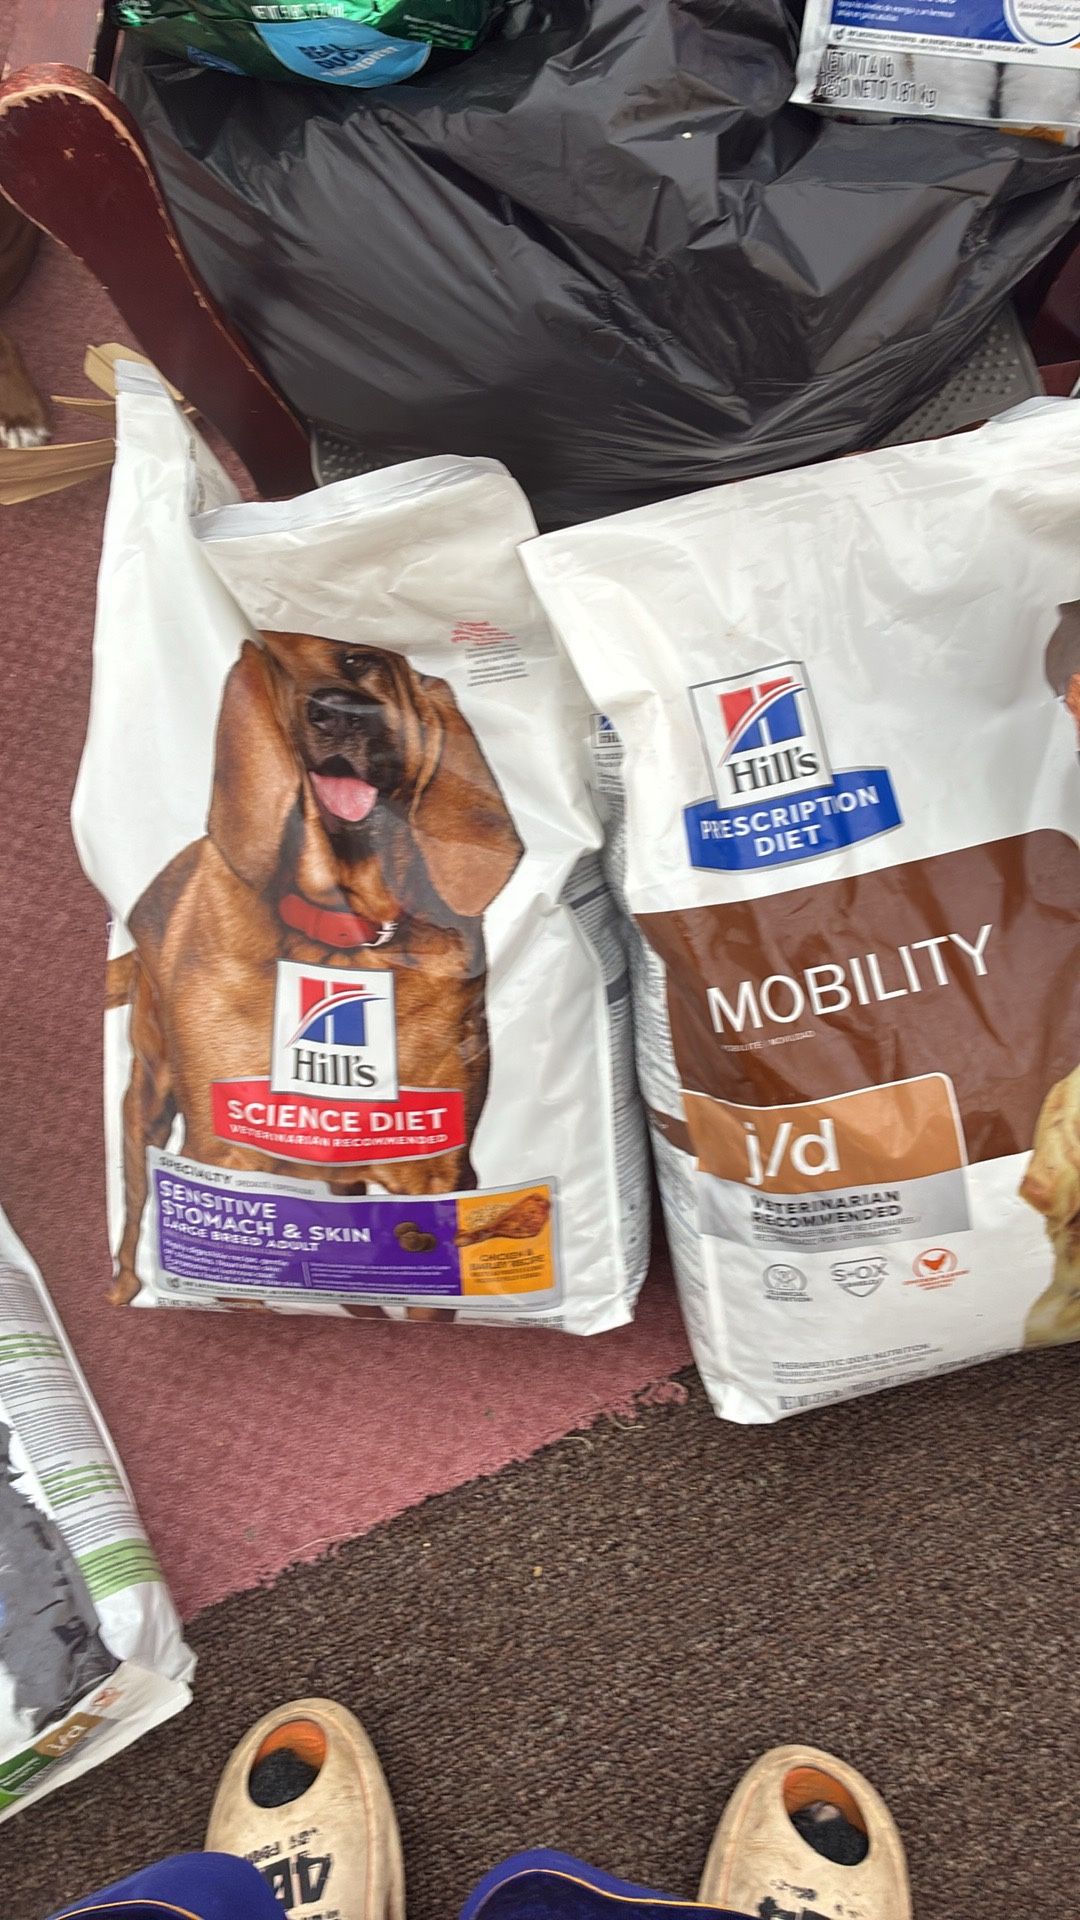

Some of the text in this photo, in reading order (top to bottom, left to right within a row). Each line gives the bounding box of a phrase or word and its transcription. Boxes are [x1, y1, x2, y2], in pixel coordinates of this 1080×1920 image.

[728, 746, 820, 794] Hill's
[701, 785, 880, 840] PRESCRIPTION
[753, 824, 822, 857] DIET
[706, 924, 993, 1033] MOBILITY
[291, 1047, 377, 1089] Hill's
[227, 1099, 448, 1132] SCIENCE DIET
[229, 1124, 448, 1147] VETERINARIAN RECOMMENDED
[744, 1118, 841, 1185] j/d
[159, 1156, 233, 1185] SPECIALTY
[159, 1180, 278, 1219] SENSITIVE
[751, 1190, 900, 1215] VETERINARIAN
[752, 1204, 903, 1228] RECOMMENDED
[161, 1199, 371, 1243] STOMACH & SKIN
[163, 1217, 208, 1238] LARGE
[210, 1231, 262, 1246] BREED
[266, 1240, 320, 1251] ADULT
